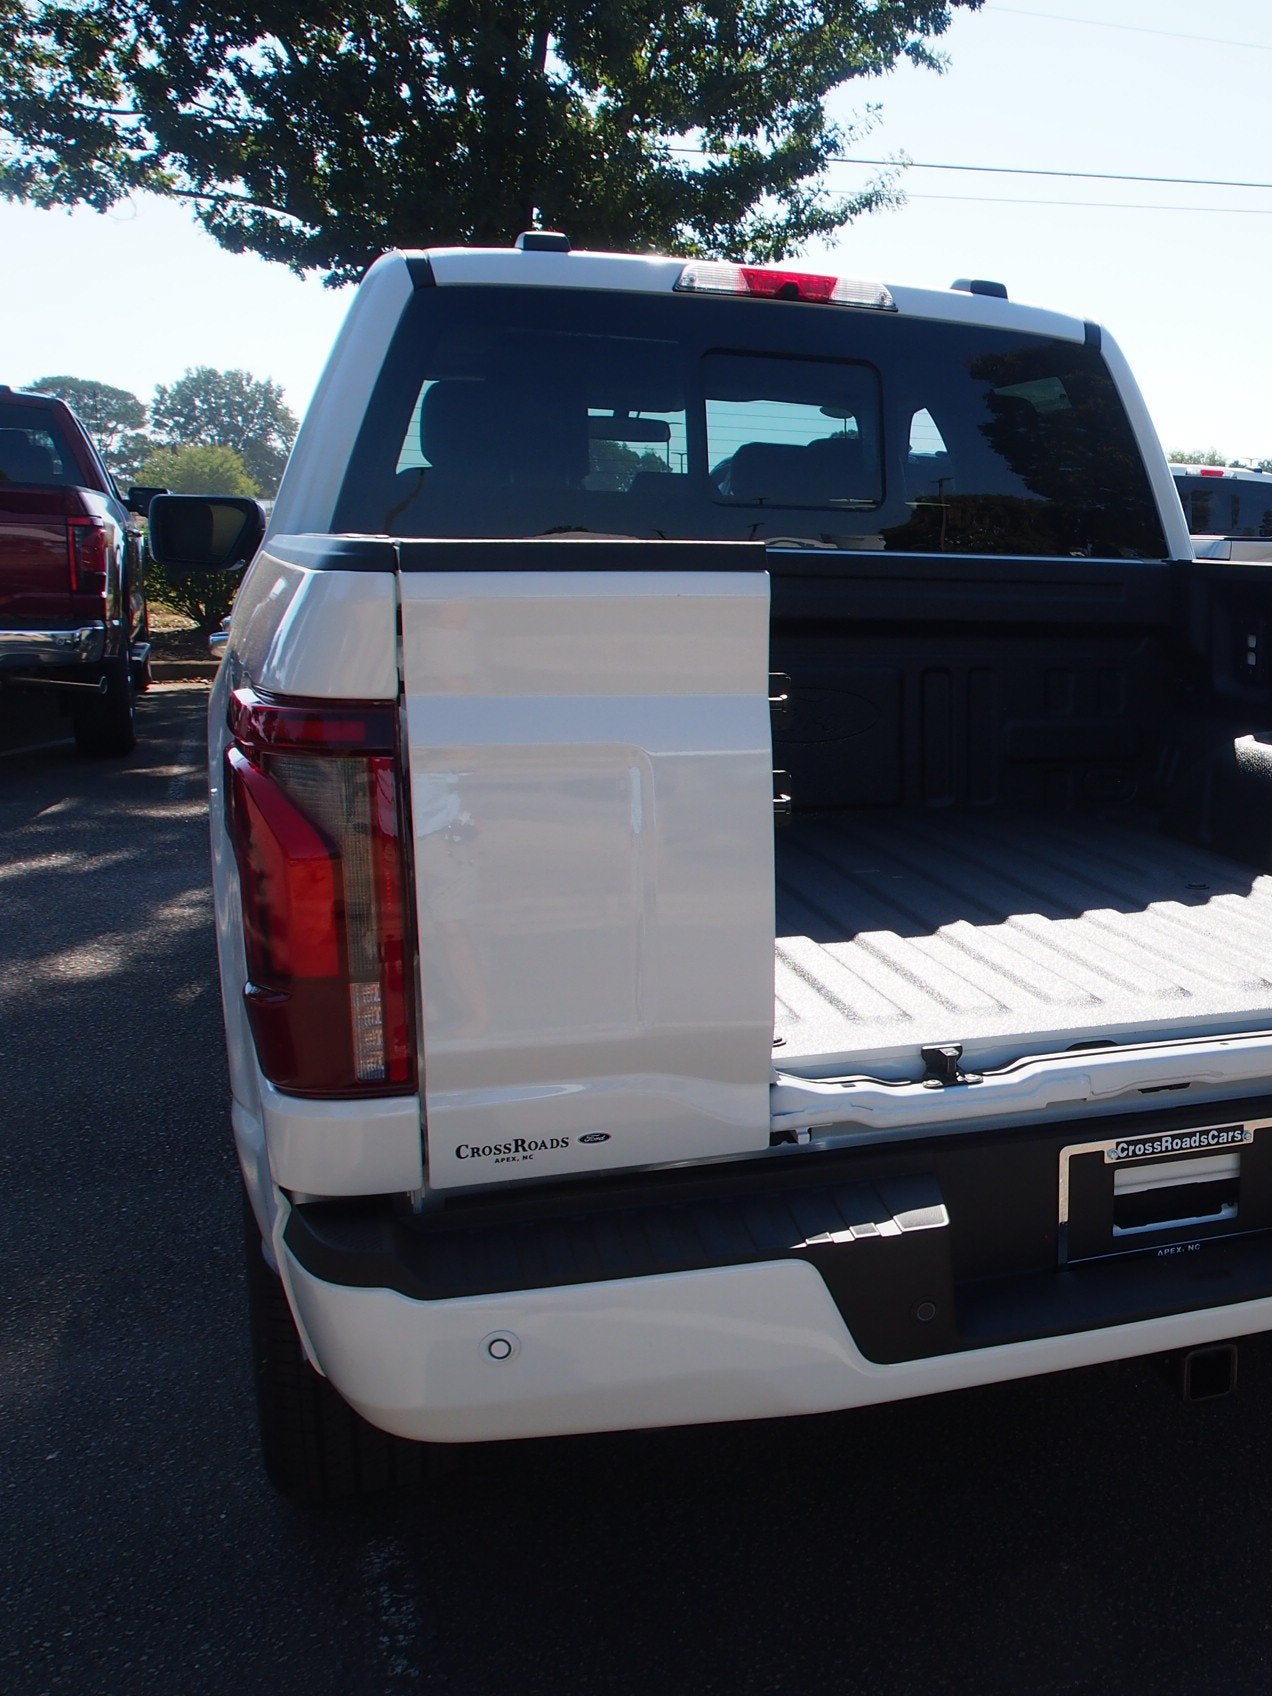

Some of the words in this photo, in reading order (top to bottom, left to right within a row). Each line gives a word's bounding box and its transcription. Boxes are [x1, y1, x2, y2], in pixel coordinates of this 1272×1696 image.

[1117, 1129, 1242, 1158] CrossRoadsCars
[494, 1155, 520, 1164] APEX,
[1187, 1243, 1201, 1252] NC
